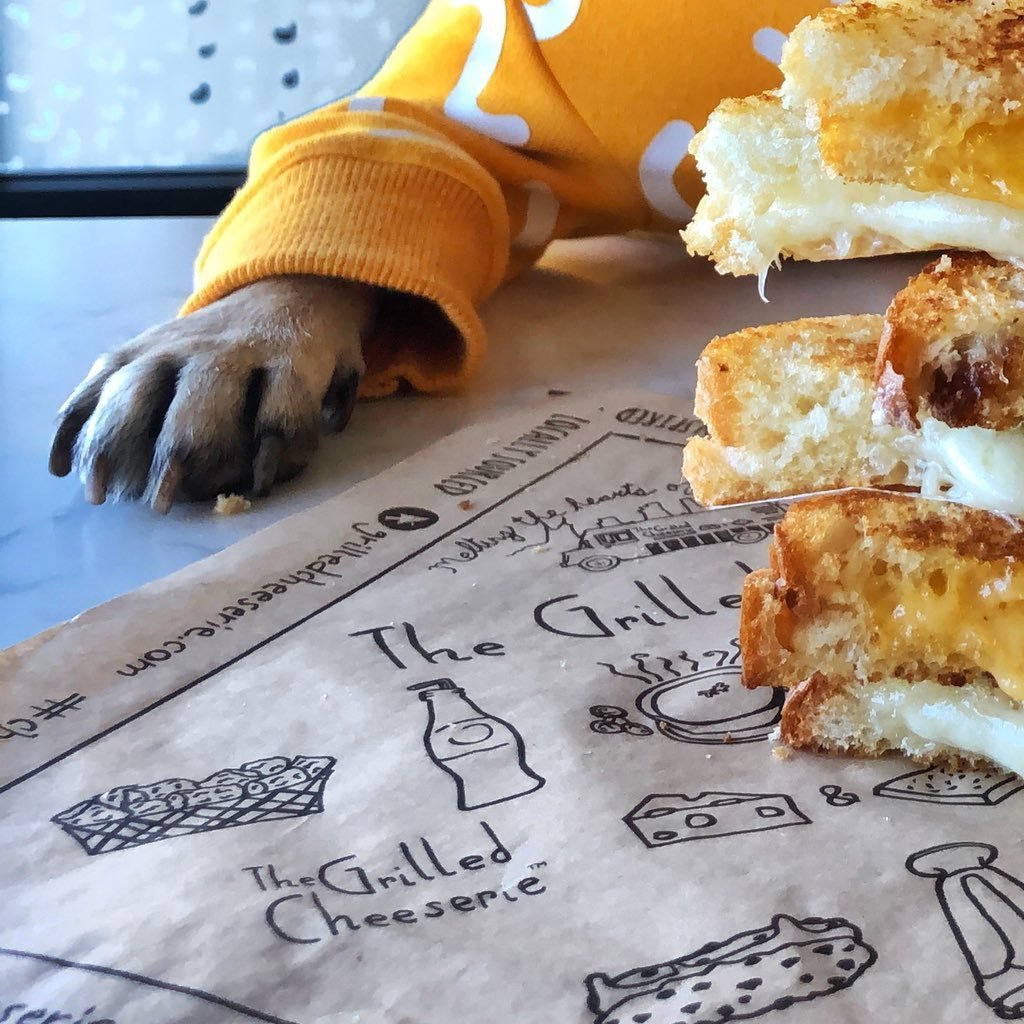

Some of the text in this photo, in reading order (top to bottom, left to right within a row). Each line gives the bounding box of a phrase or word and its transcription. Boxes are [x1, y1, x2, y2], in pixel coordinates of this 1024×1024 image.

[615, 407, 709, 439] NSPIRED
[116, 521, 390, 677] grilledcheeserie.com
[348, 560, 752, 669] The Grille
[241, 821, 512, 895] The Grilled
[265, 875, 547, 944] Cheeserie
